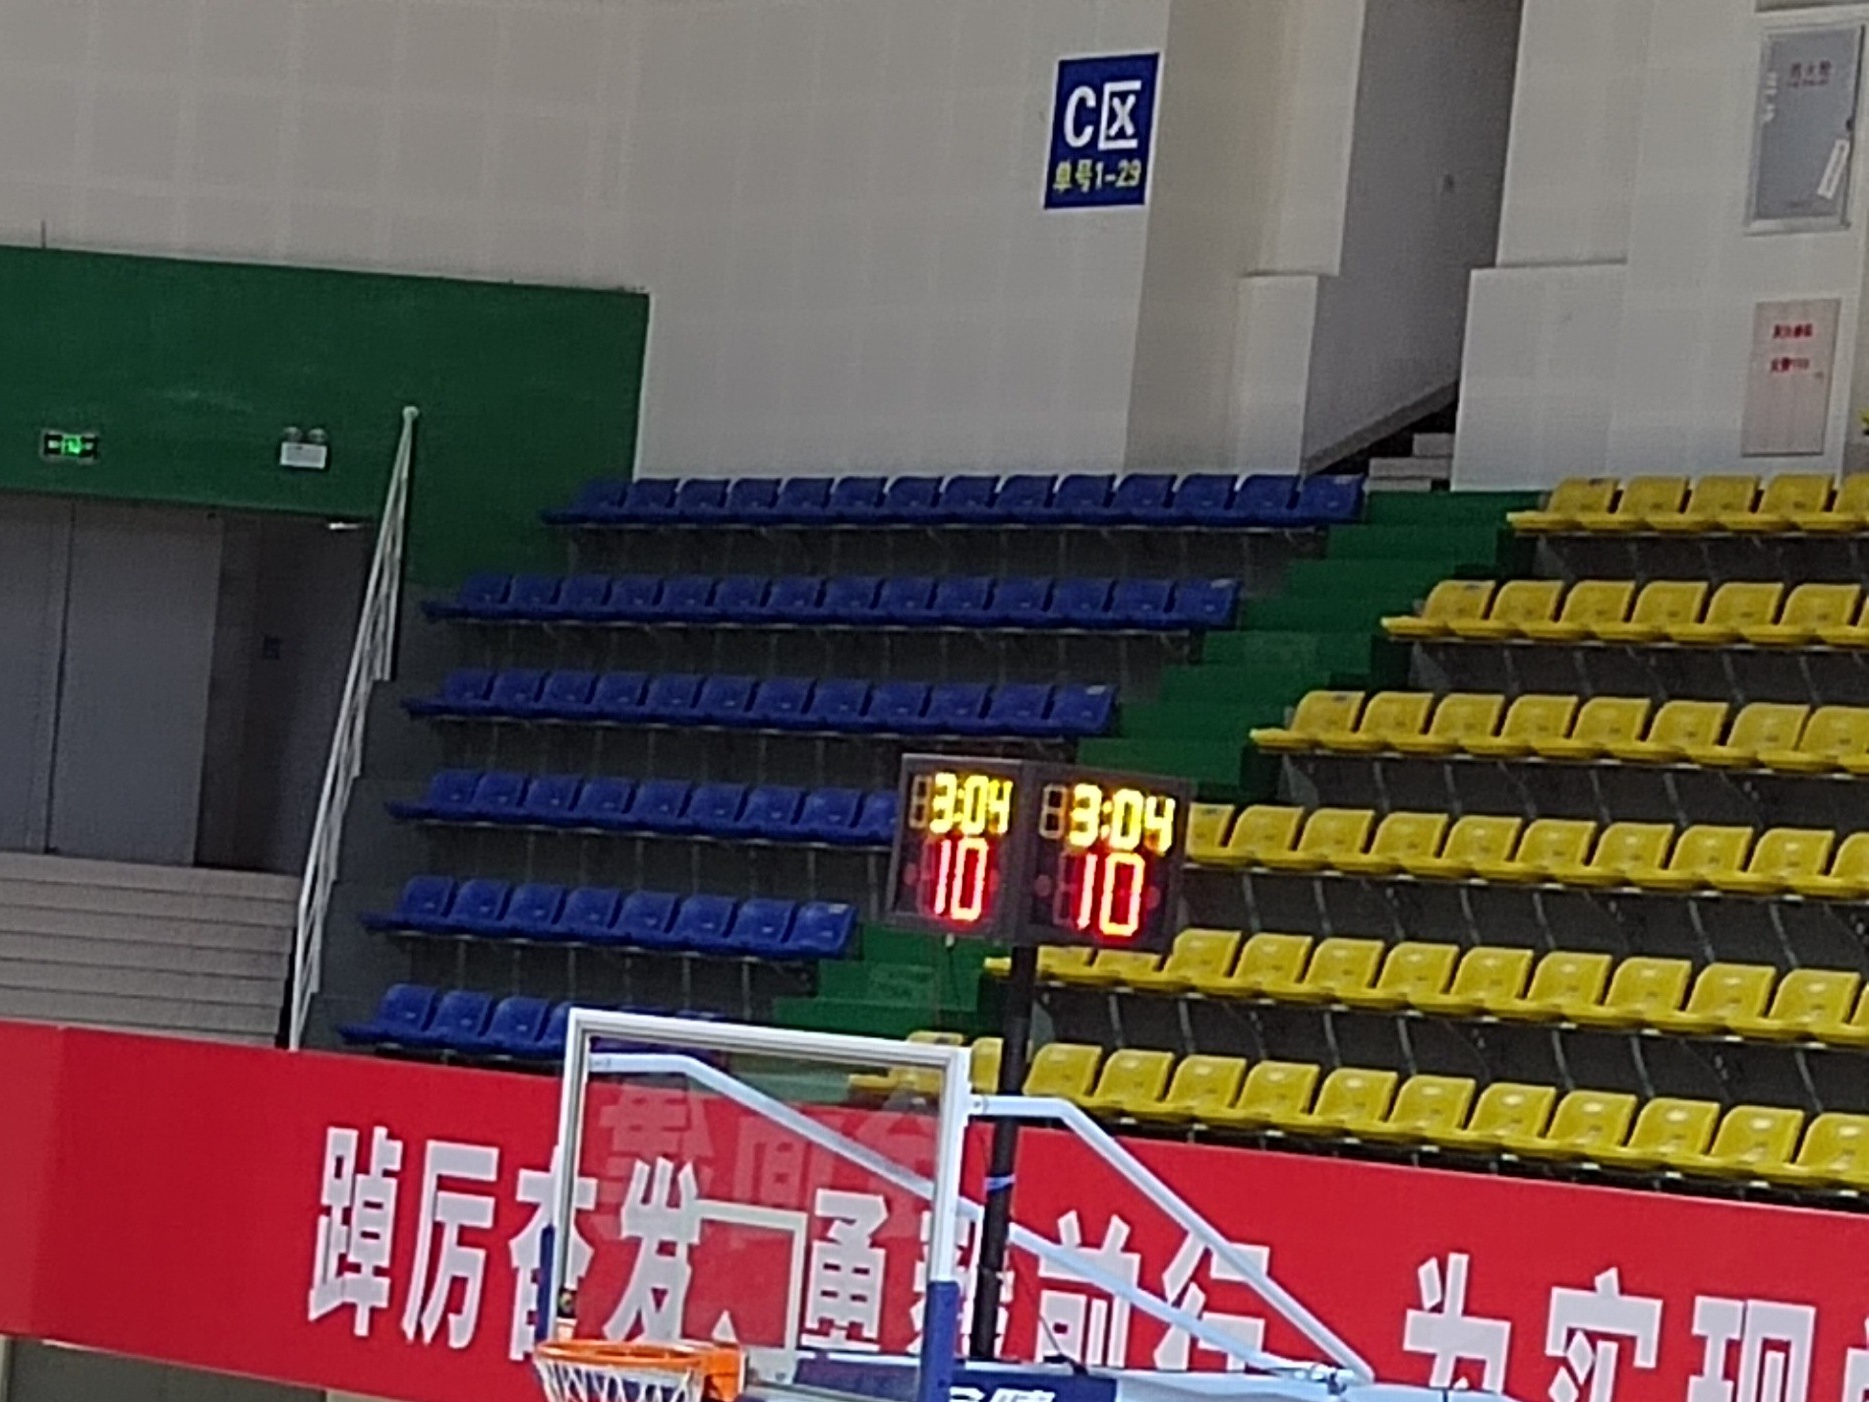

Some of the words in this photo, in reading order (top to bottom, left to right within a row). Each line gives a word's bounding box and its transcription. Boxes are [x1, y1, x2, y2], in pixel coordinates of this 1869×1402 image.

[1064, 80, 1142, 150] C区
[1052, 159, 1142, 193] 单号1-29
[930, 772, 1013, 835] 3:04
[1068, 783, 1176, 855] 3:04
[934, 838, 989, 921] 10
[1076, 852, 1146, 936] 10
